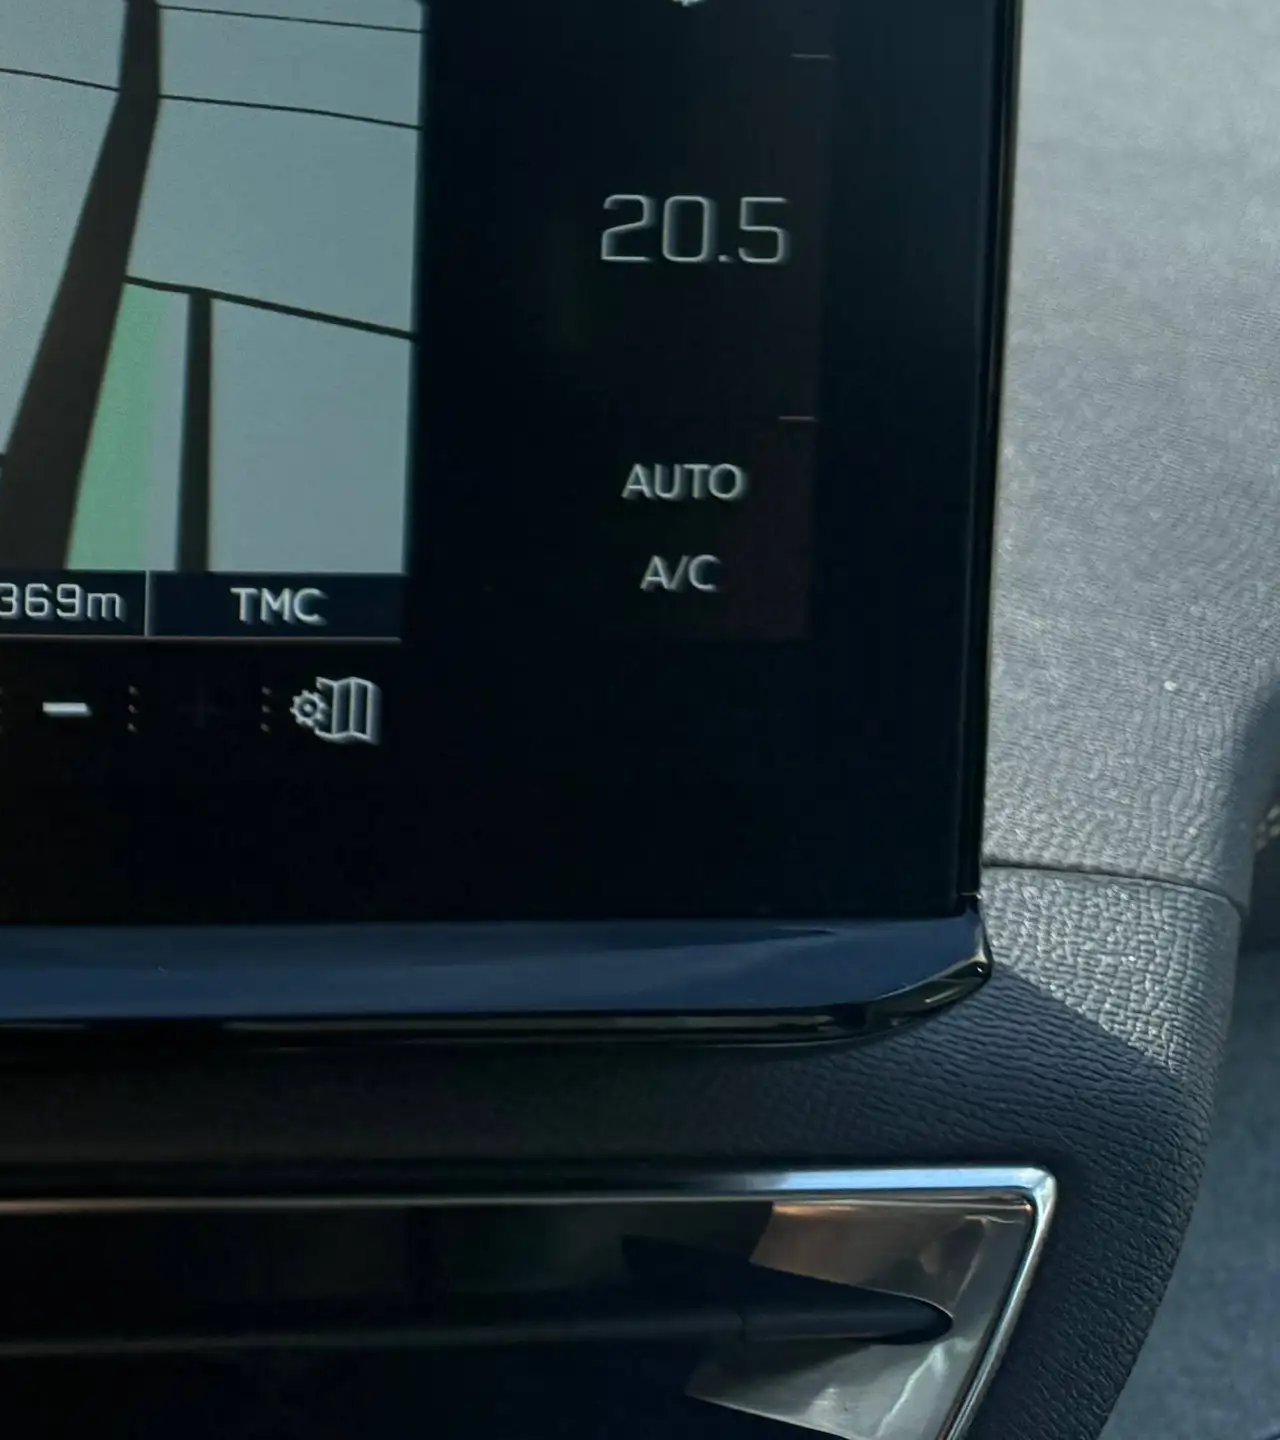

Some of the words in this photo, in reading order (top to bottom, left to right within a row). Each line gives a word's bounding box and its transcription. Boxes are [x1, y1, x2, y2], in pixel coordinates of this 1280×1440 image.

[601, 194, 793, 264] 20.5
[621, 462, 748, 500] AUTO
[639, 554, 721, 592] A/C
[229, 586, 328, 625] TMC
